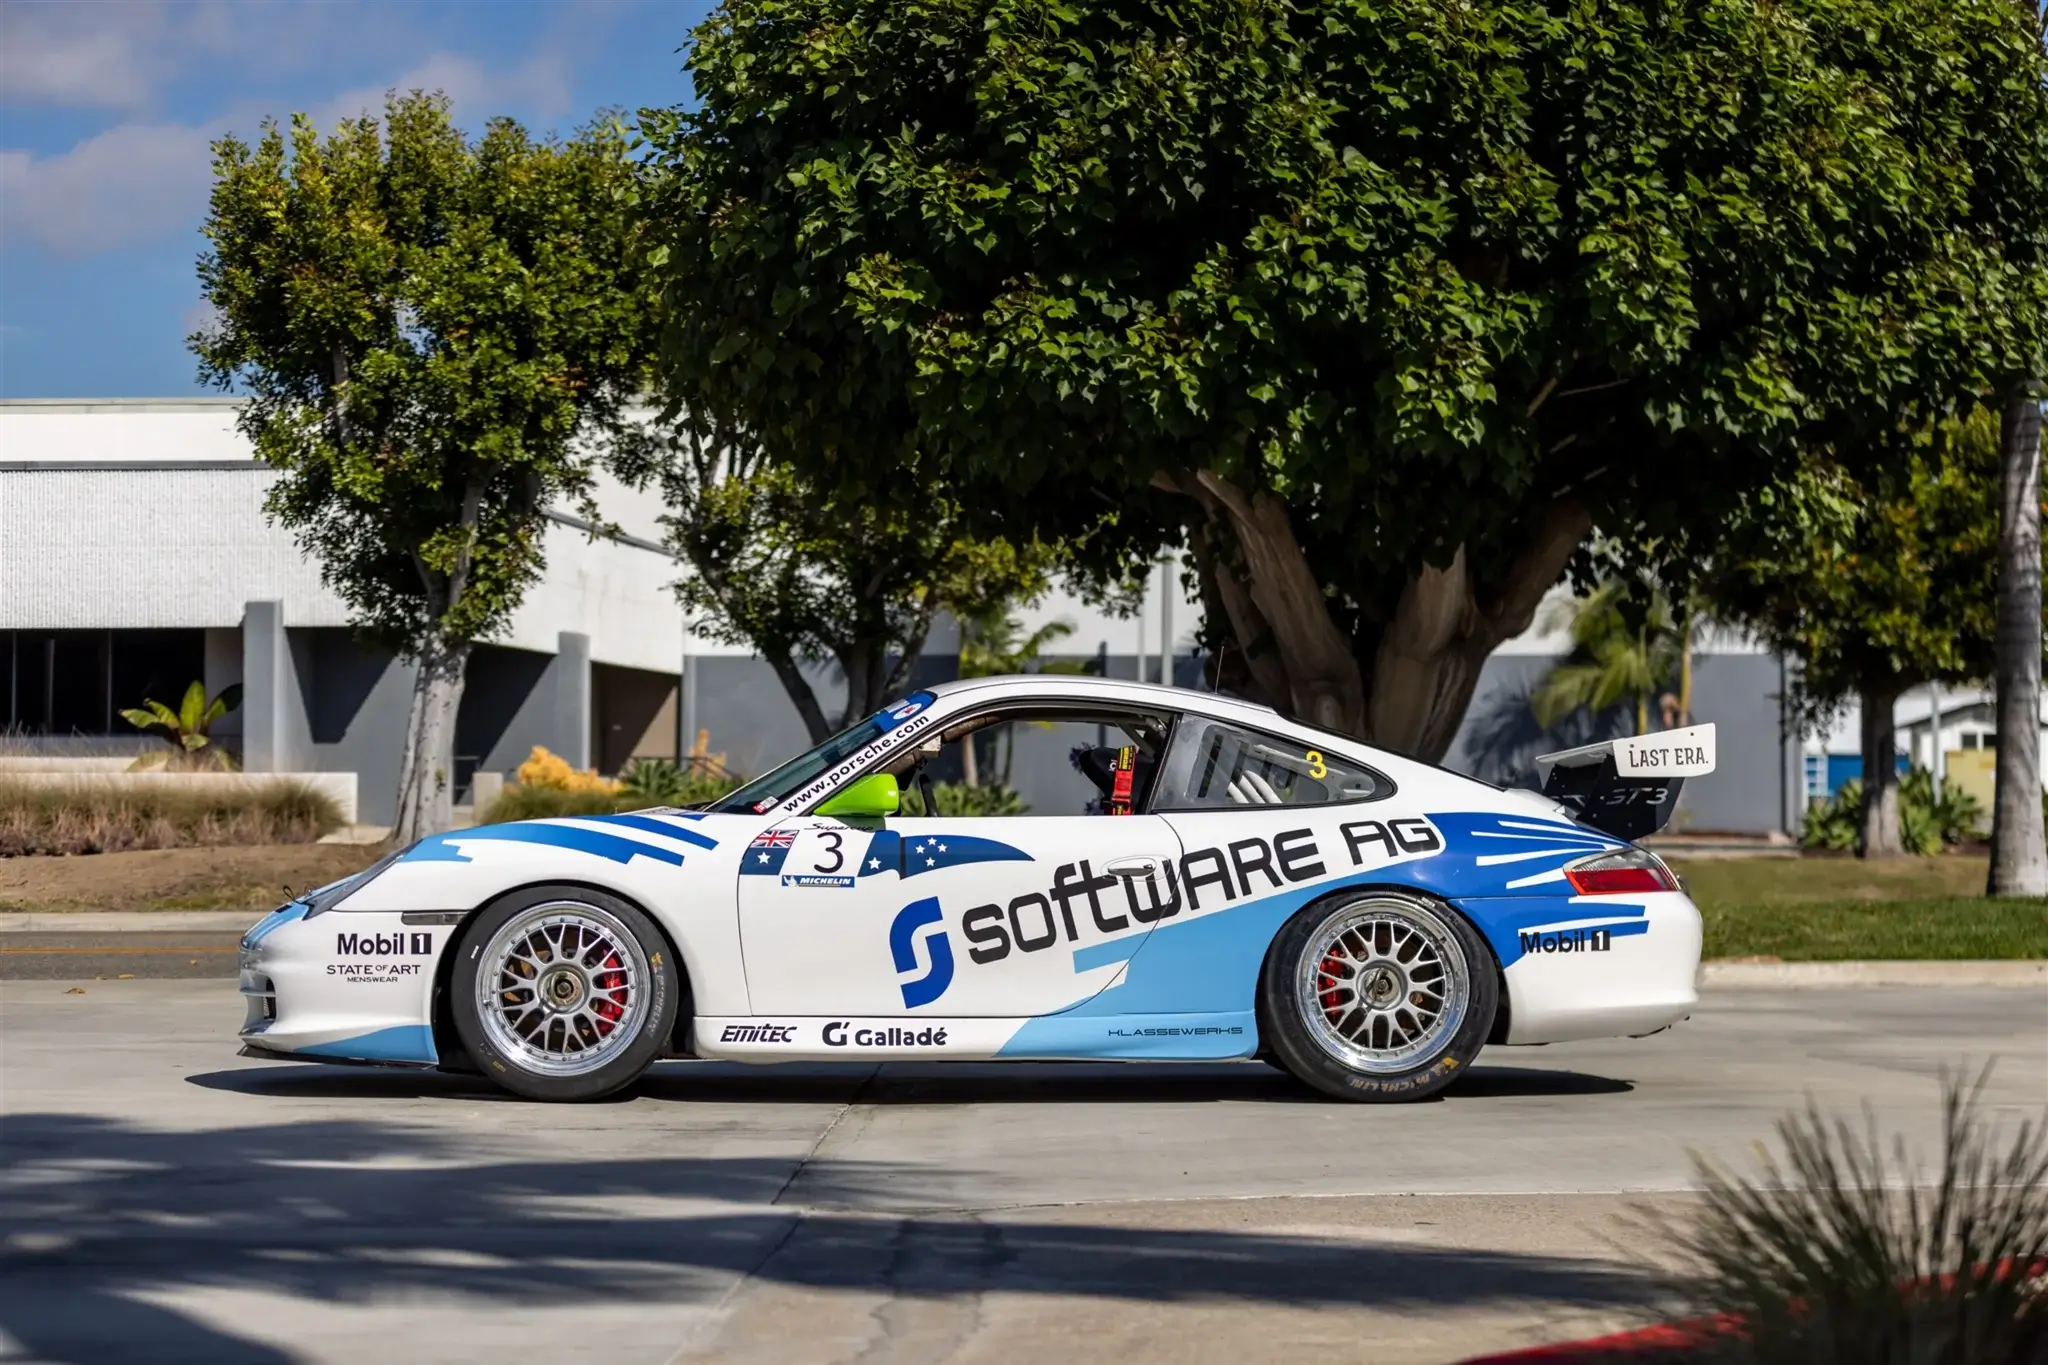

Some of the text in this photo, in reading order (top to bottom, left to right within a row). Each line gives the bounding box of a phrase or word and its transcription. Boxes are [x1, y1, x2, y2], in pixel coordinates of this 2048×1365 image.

[783, 715, 930, 813] www.porsche.com
[1306, 750, 1327, 779] 3
[1629, 747, 1709, 768] LAST ERA.
[806, 822, 874, 832] Supercup
[813, 831, 844, 874] 3
[1340, 817, 1440, 866] AG
[799, 877, 852, 886] MICHELIN
[337, 932, 405, 956] Mobil
[1520, 930, 1586, 954] Mobil
[326, 964, 421, 975] STATE OF ART
[1108, 1026, 1243, 1037] KLASSEWERKS
